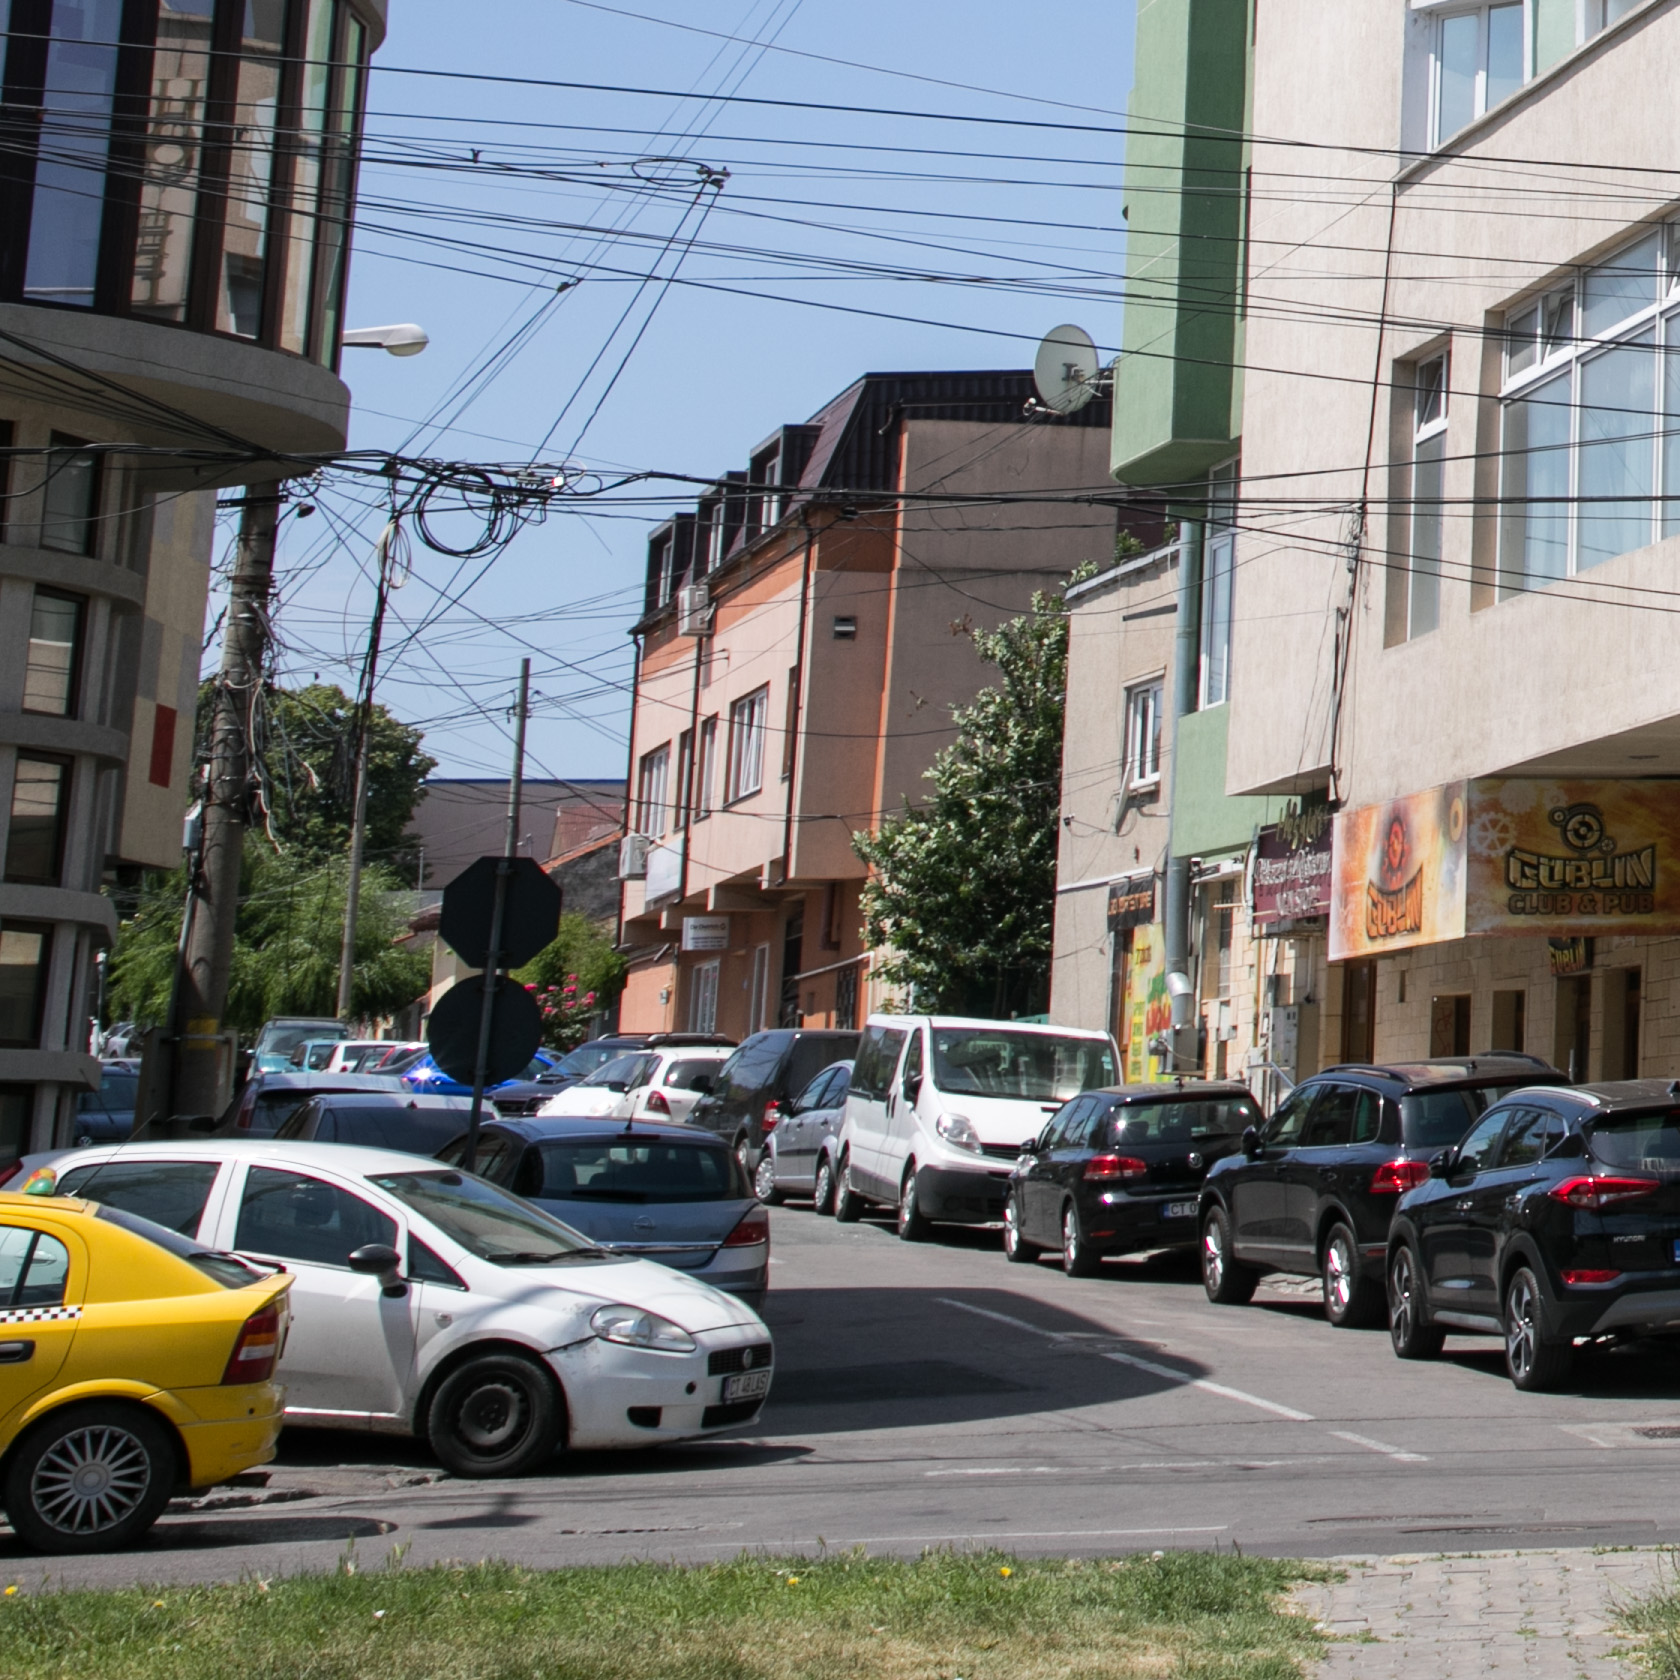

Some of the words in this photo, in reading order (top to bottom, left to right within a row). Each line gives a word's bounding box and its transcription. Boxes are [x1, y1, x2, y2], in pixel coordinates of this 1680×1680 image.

[1508, 894, 1571, 915] CLUB
[1578, 894, 1600, 915] &
[1602, 893, 1655, 914] PUB
[1171, 1203, 1186, 1216] CT
